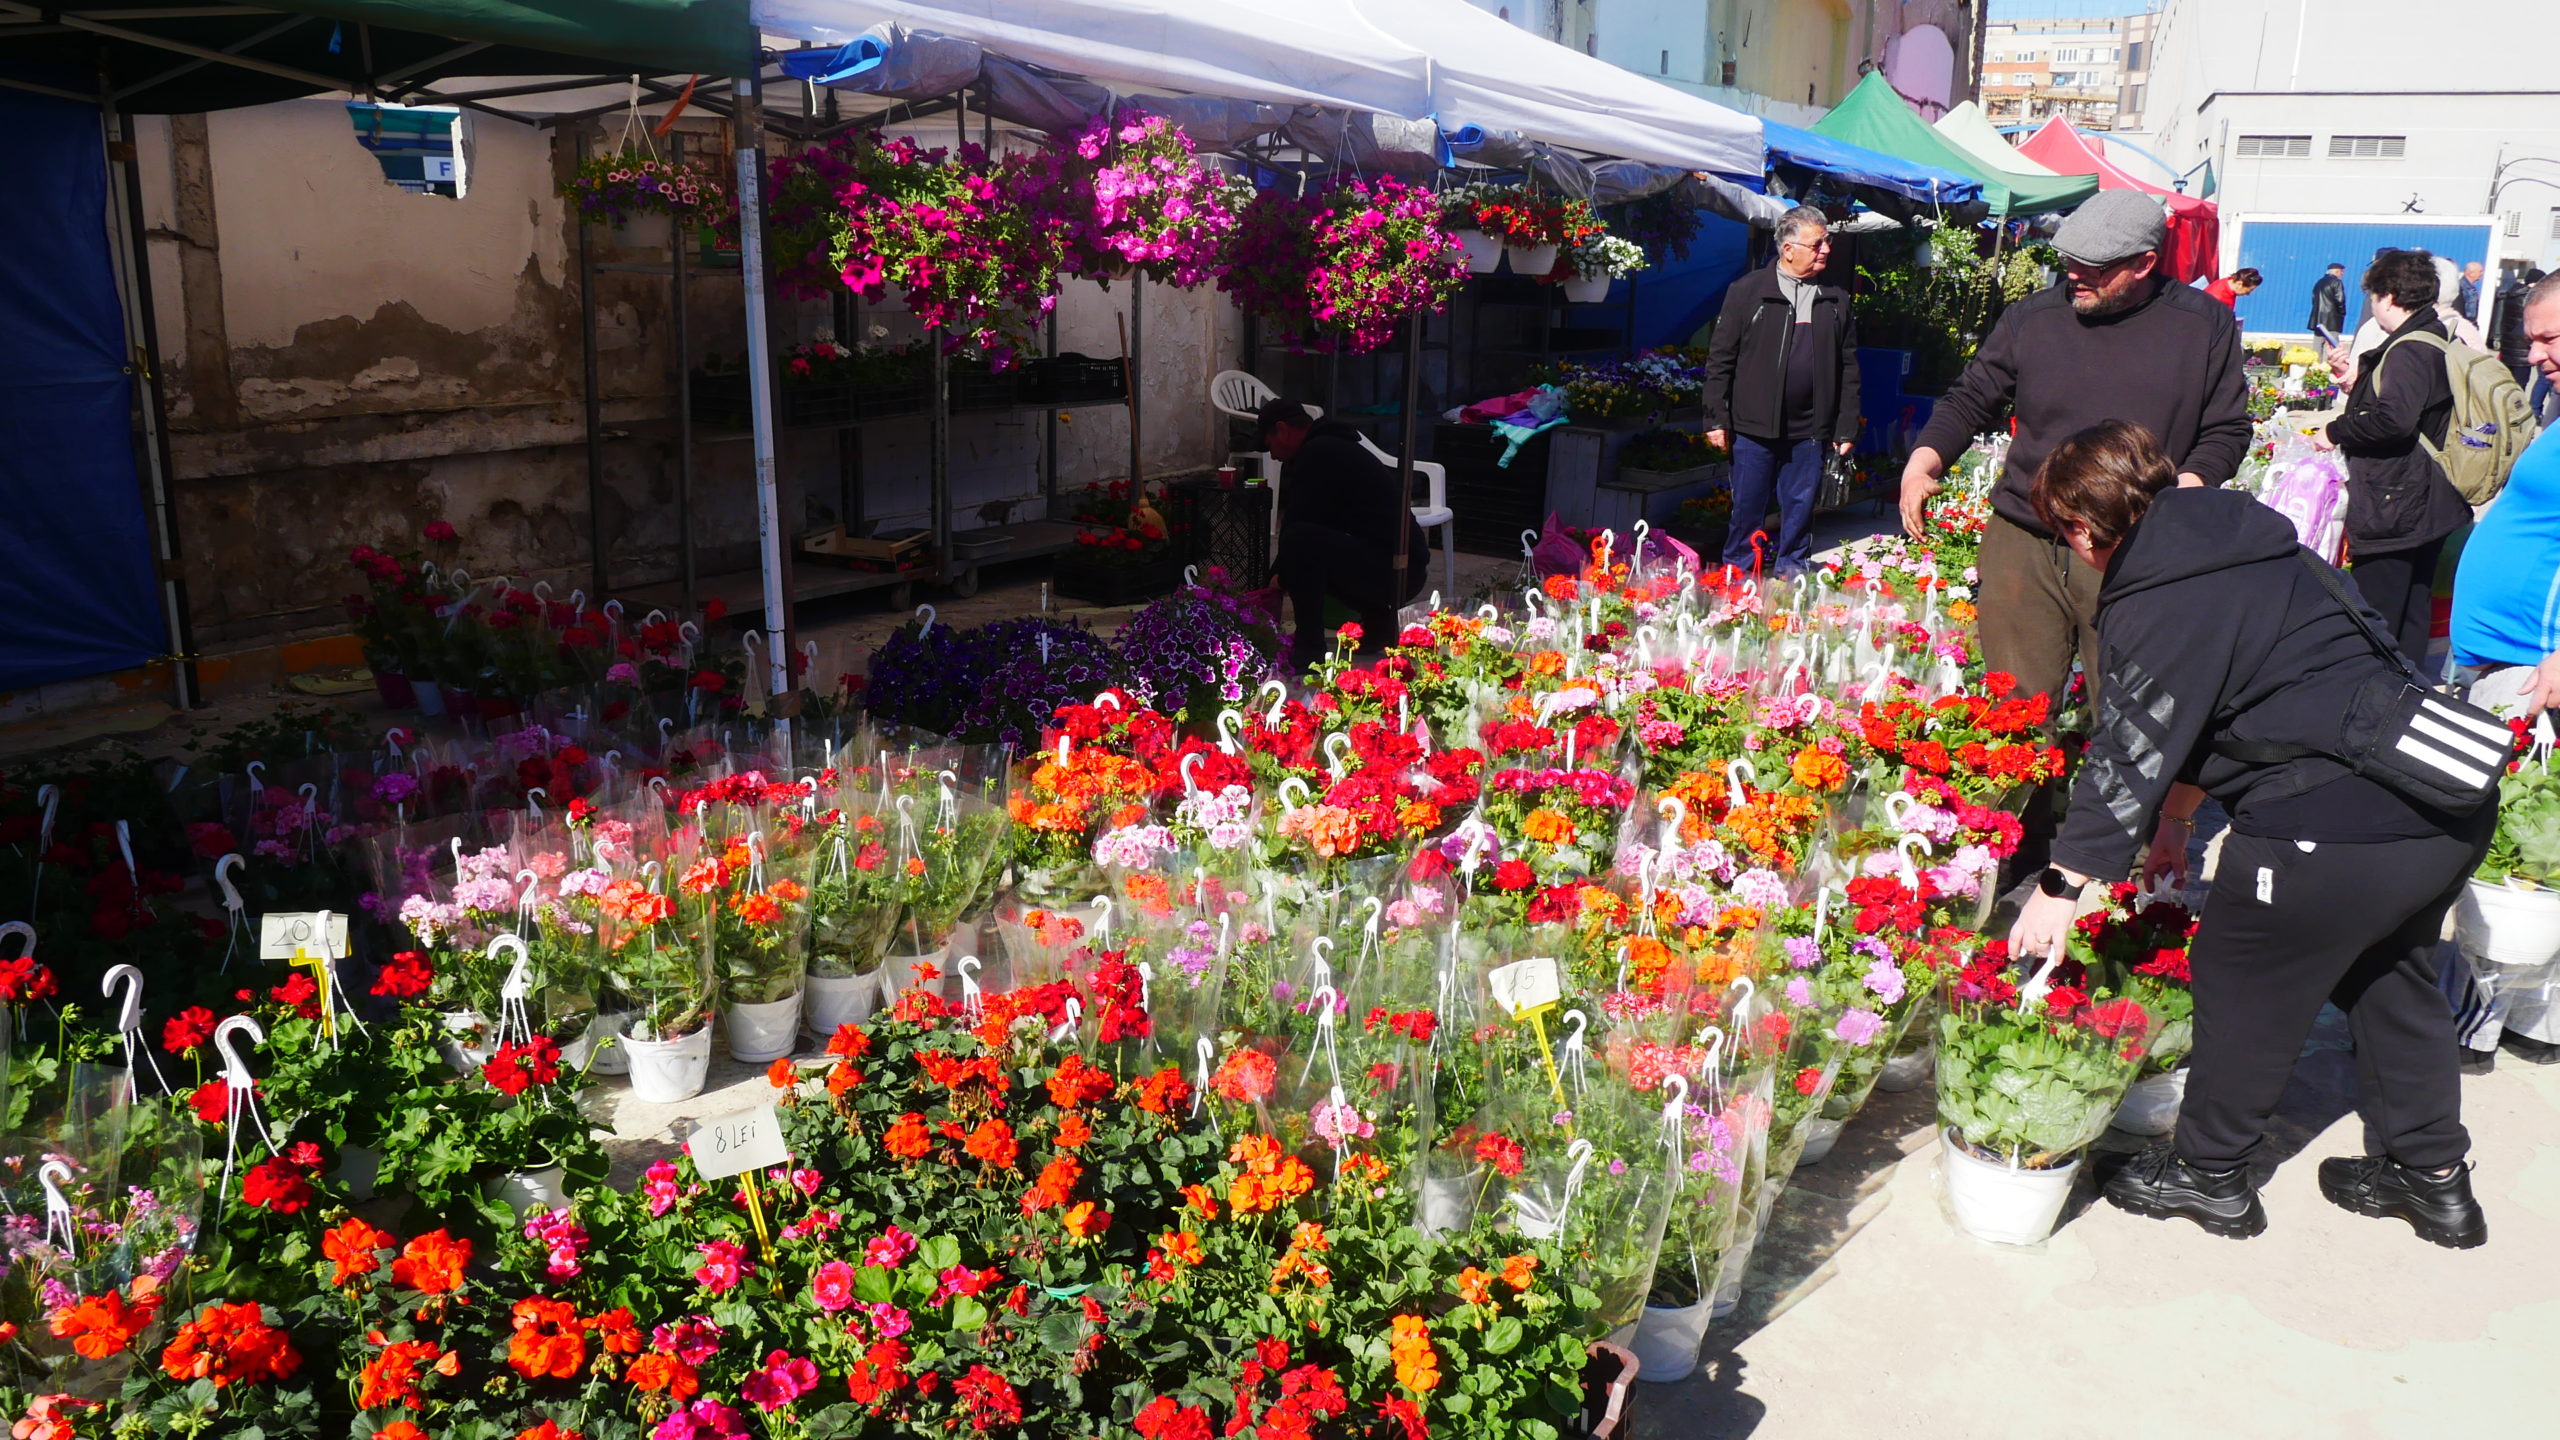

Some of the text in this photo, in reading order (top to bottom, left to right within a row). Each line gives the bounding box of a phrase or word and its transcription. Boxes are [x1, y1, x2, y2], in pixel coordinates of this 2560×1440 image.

[439, 161, 451, 177] F
[271, 916, 311, 947] 20
[1507, 964, 1536, 1002] 15
[714, 1125, 727, 1154] 8
